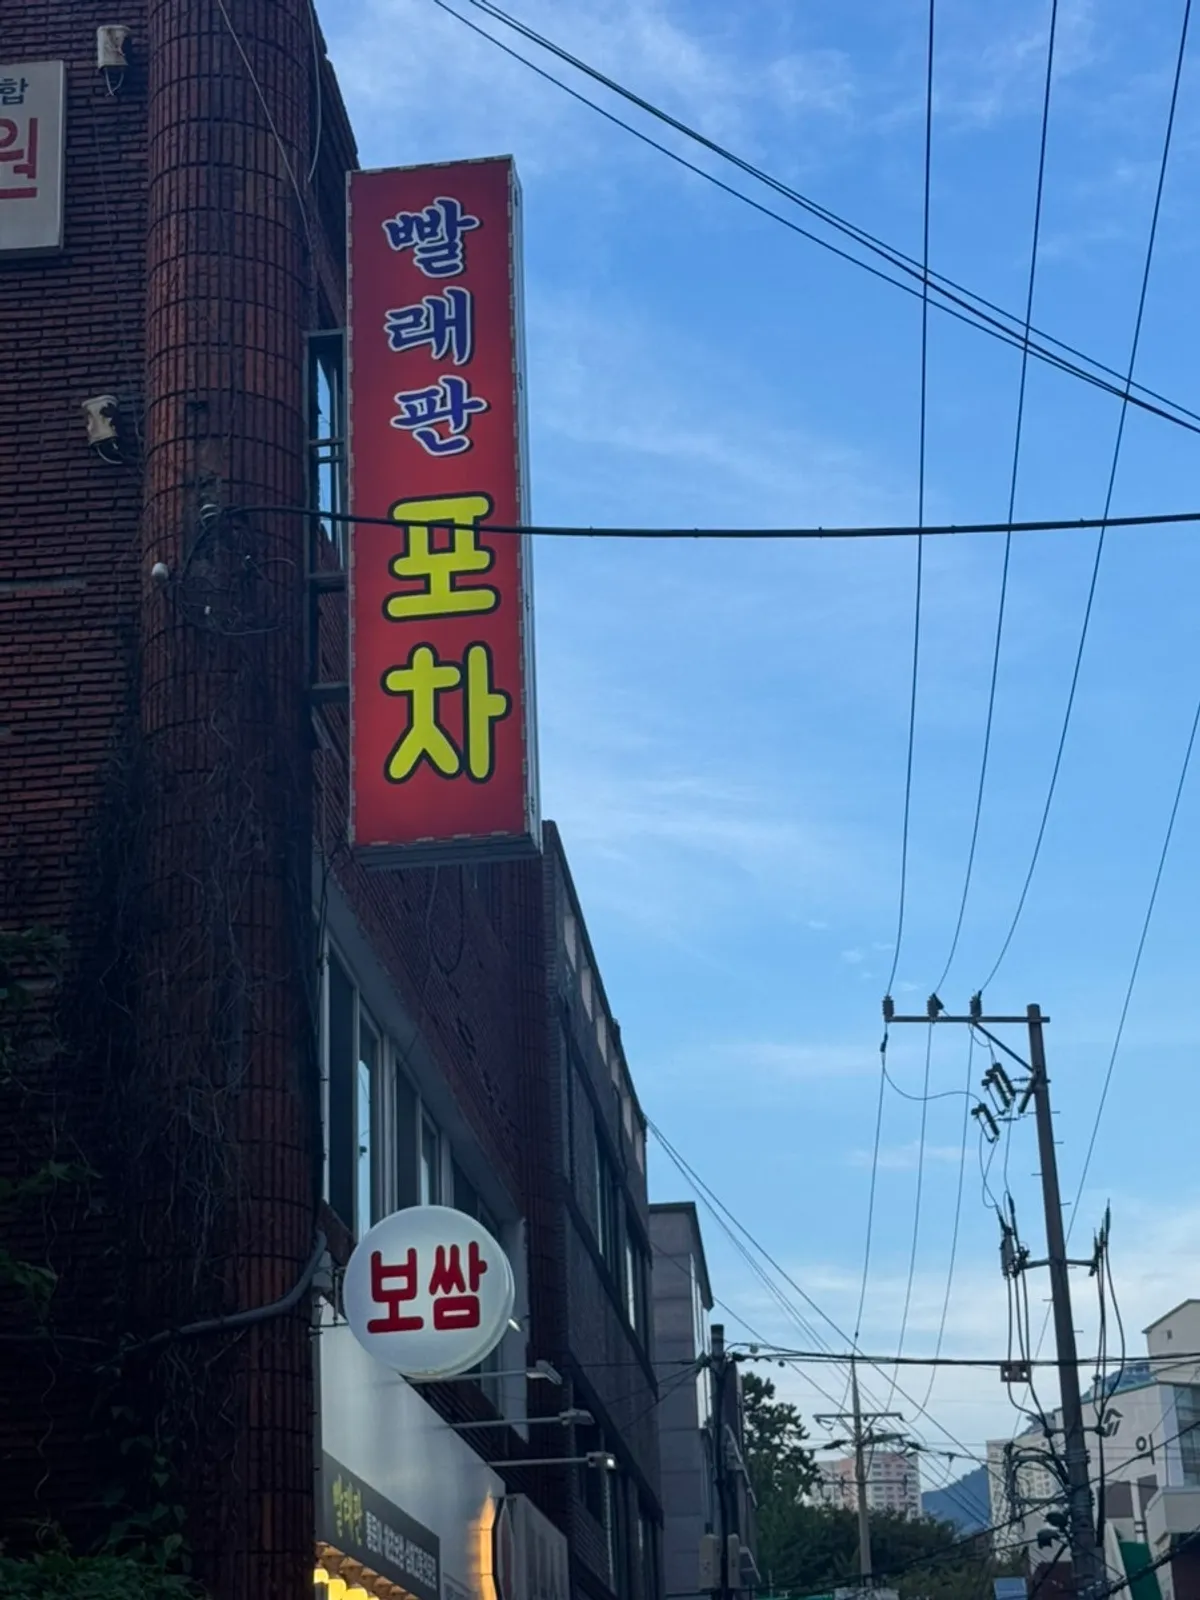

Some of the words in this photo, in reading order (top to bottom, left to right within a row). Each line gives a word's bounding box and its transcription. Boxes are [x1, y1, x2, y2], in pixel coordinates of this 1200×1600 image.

[382, 196, 488, 457] 빨래판
[382, 492, 511, 784] 포차
[367, 1240, 488, 1334] 보쌈
